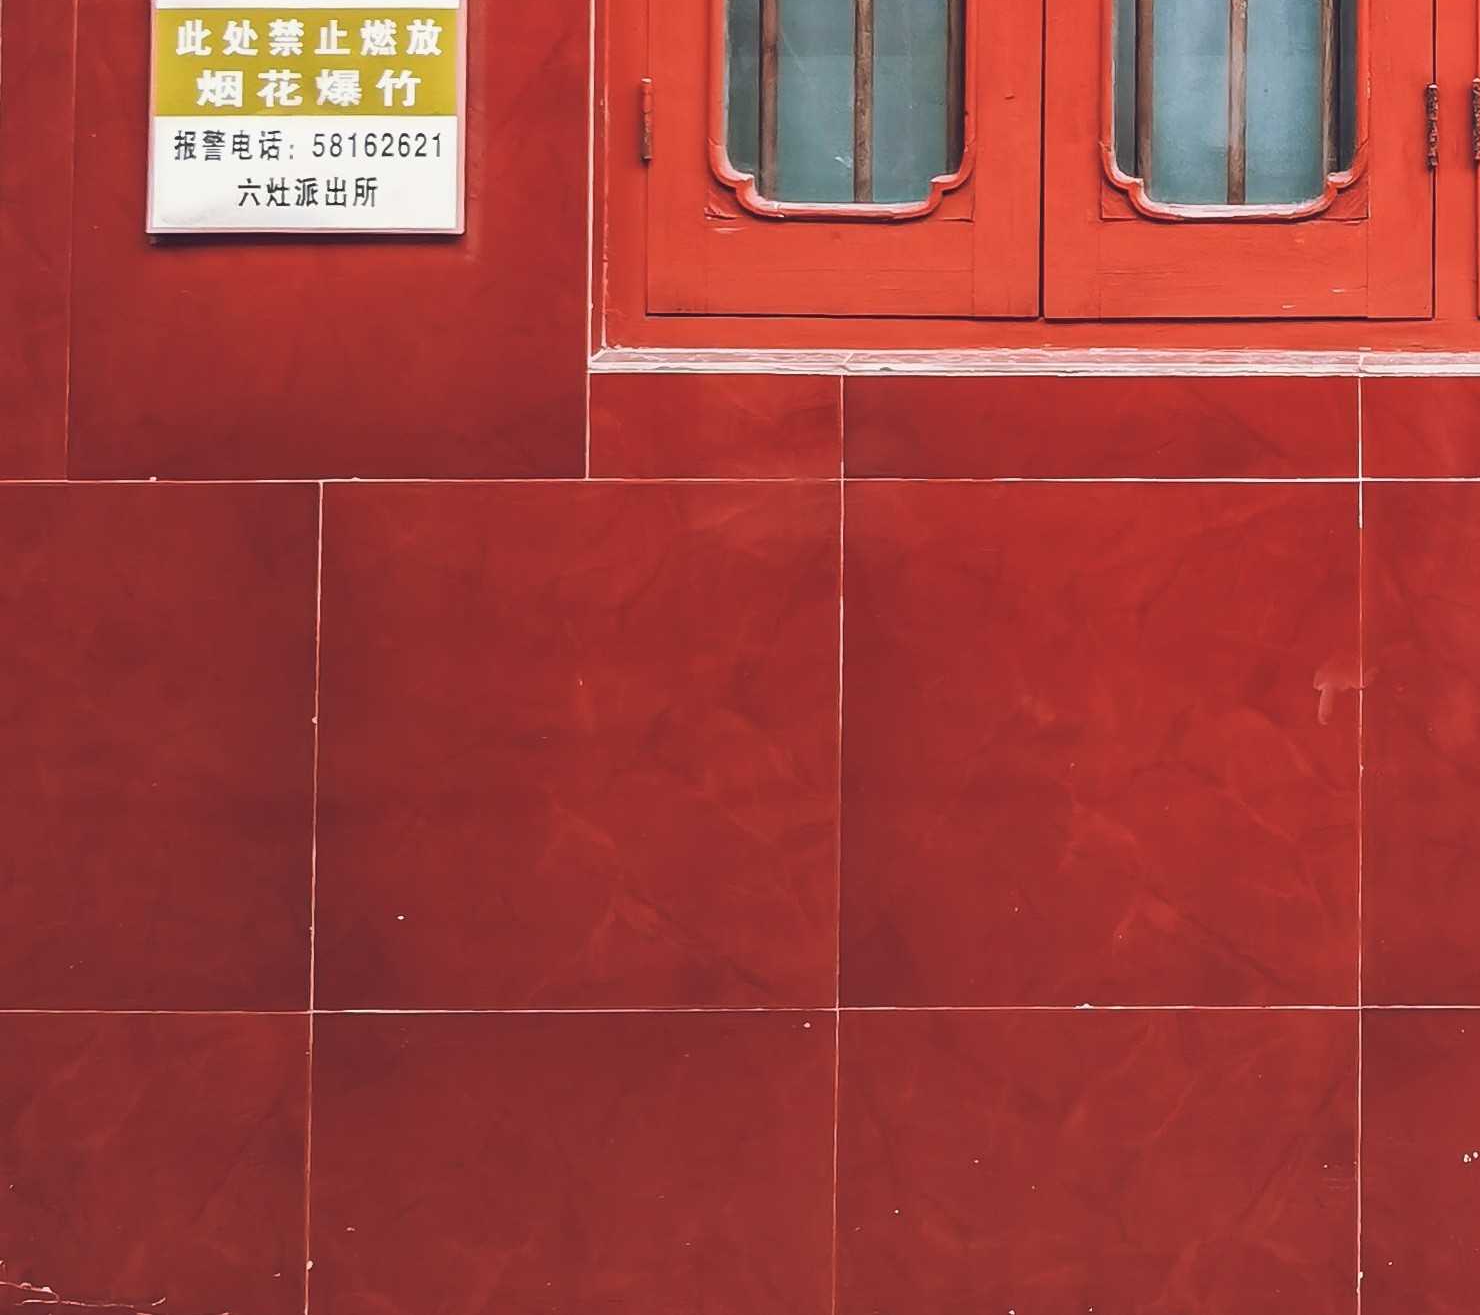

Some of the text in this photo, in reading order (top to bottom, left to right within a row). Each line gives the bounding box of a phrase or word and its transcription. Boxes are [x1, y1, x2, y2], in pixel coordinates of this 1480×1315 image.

[175, 19, 443, 57] 此处禁止燃放
[196, 69, 422, 108] 烟花爆竹
[236, 176, 379, 208] 六灶派出所
